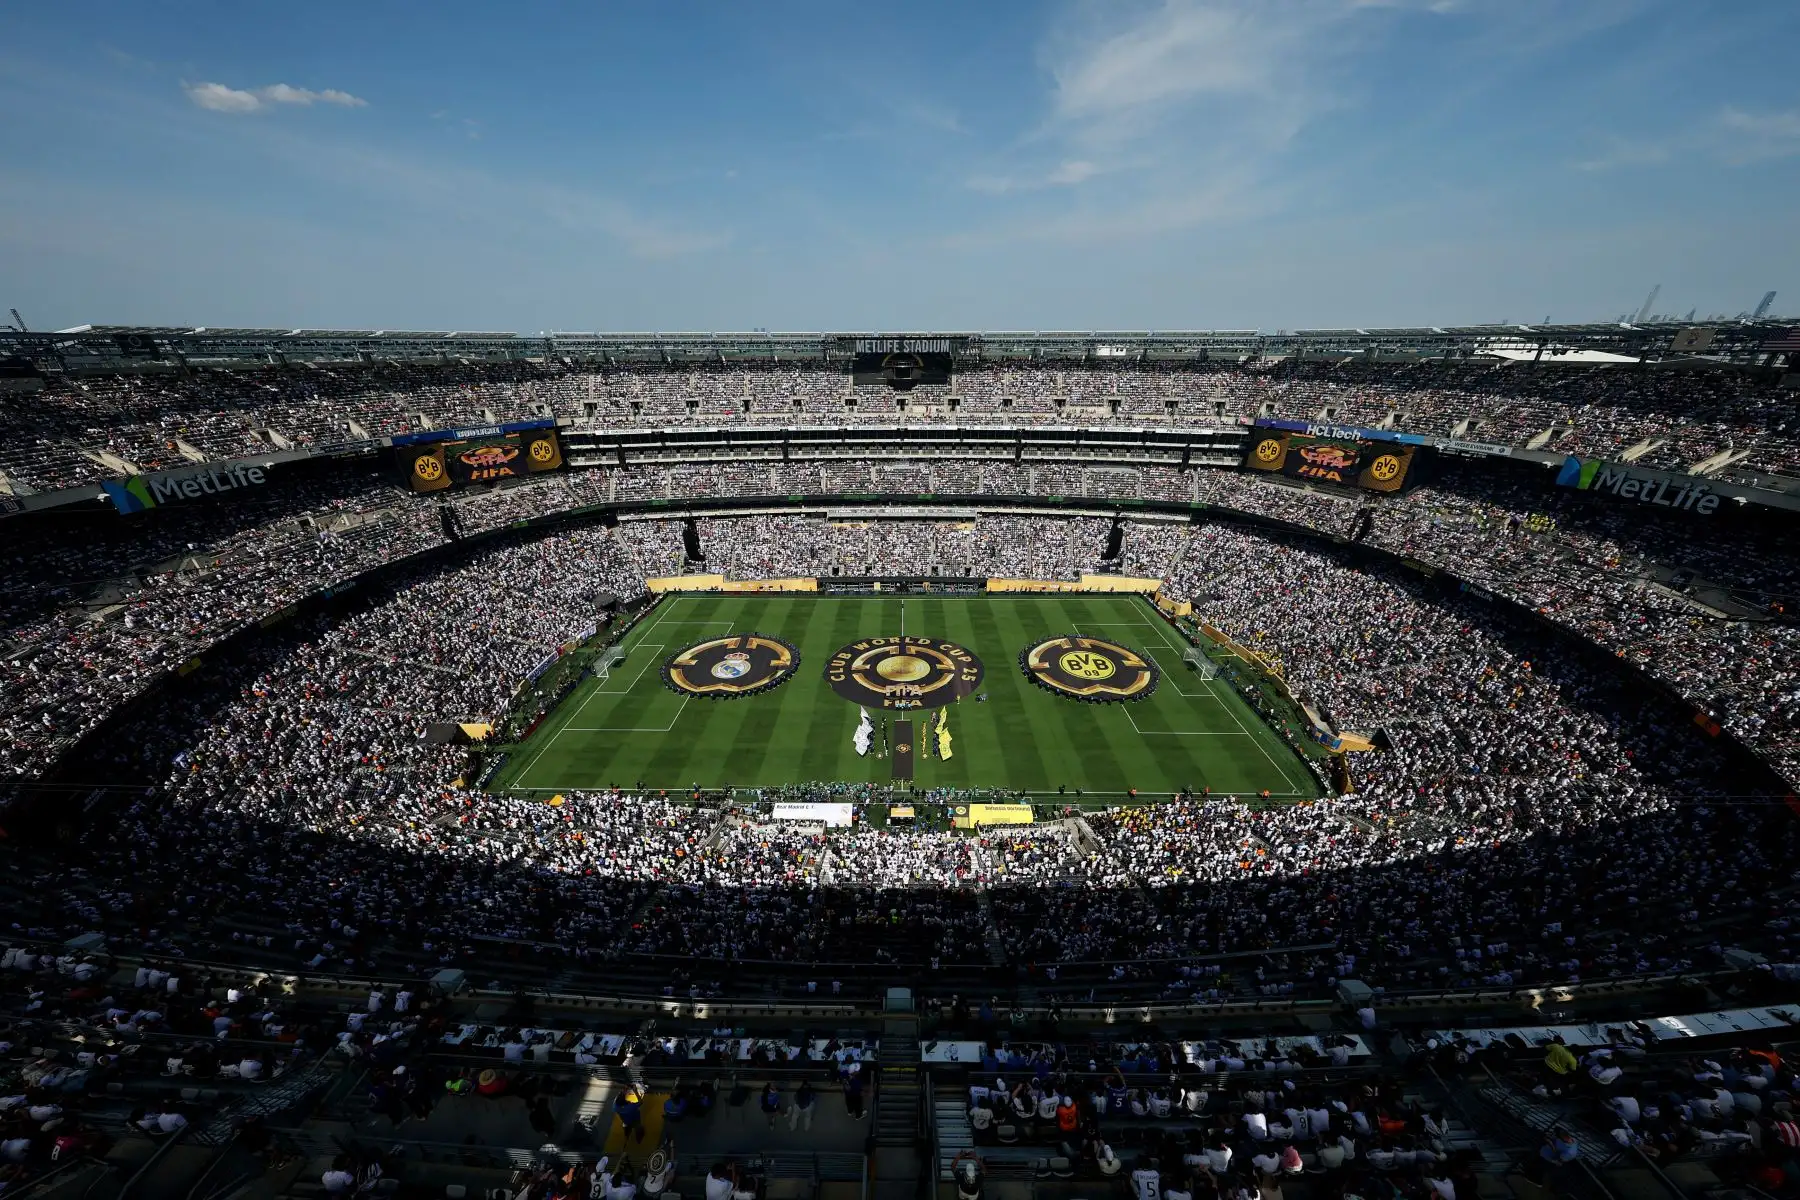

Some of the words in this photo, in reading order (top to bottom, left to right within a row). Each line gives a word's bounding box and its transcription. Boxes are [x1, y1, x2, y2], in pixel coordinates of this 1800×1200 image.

[856, 340, 900, 353] METLIFE
[903, 340, 950, 353] STADIUM
[1306, 425, 1361, 440] HCLTech
[533, 442, 551, 456] BVB
[1259, 441, 1277, 456] BVB
[418, 458, 440, 475] BVB
[1375, 457, 1397, 474] BVB
[470, 467, 515, 480] FIFA
[1297, 465, 1342, 482] FIFA
[150, 463, 267, 504] MetLife
[1594, 469, 1720, 515] MetLife
[333, 580, 357, 594] MetLife
[1469, 585, 1494, 602] MetLife
[830, 652, 852, 681] CLUB
[852, 637, 931, 651] WORLD
[939, 644, 972, 662] CUP
[961, 667, 978, 682] 25
[1066, 654, 1109, 671] BVB
[1083, 669, 1101, 677] 09
[885, 684, 923, 697] FIFA
[1115, 1098, 1123, 1108] 5
[1299, 1116, 1307, 1129] 9
[593, 1184, 602, 1199] 9
[1146, 1181, 1156, 1197] 5
